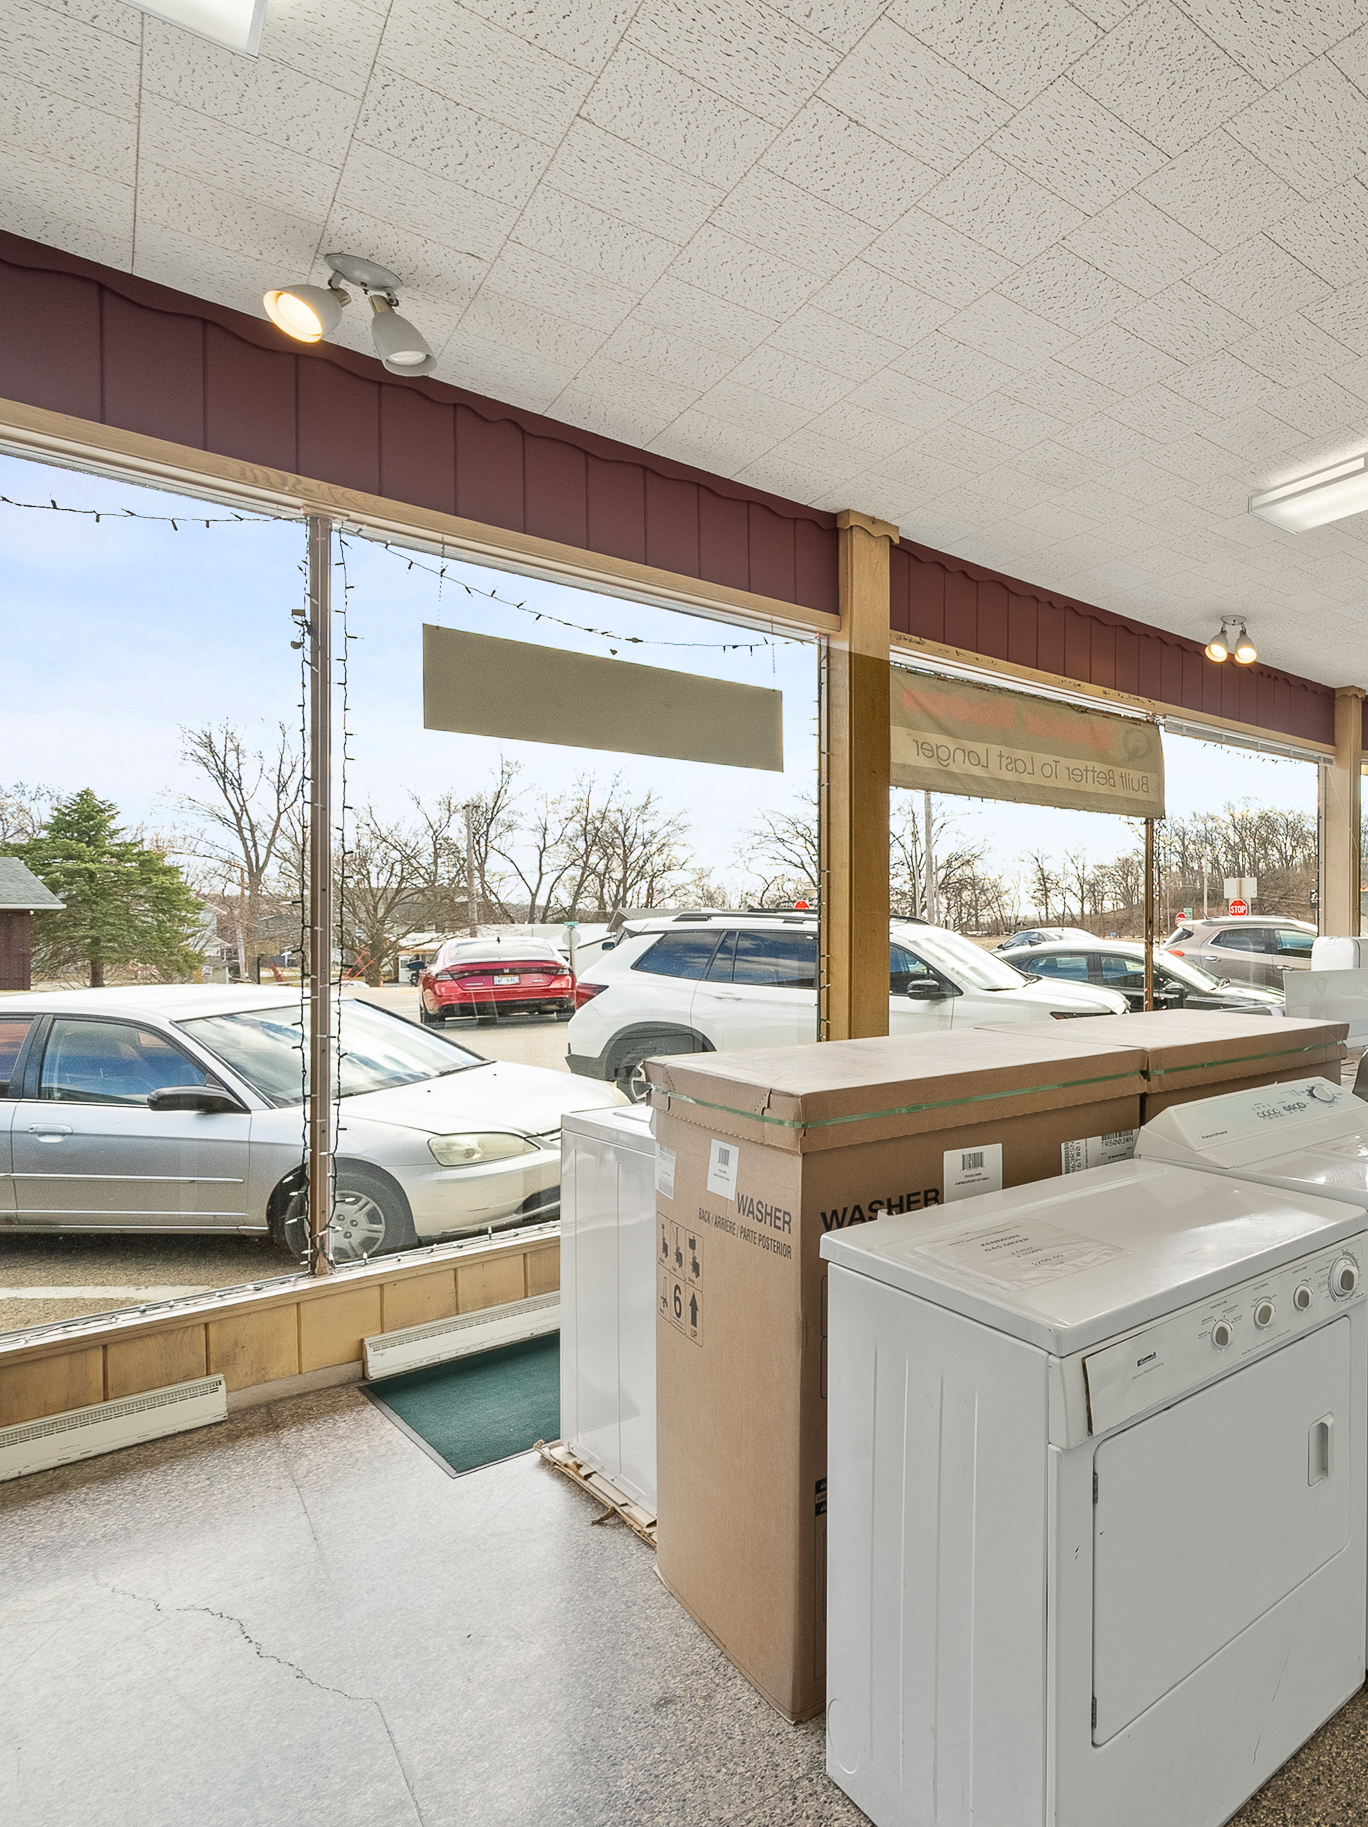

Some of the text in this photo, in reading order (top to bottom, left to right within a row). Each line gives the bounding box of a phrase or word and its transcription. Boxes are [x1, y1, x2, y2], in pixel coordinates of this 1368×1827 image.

[1230, 905, 1246, 914] STOP
[737, 1192, 792, 1235] WASHER
[820, 1188, 942, 1232] WASHER
[698, 1207, 711, 1225] BACK
[713, 1214, 736, 1236] ARRIÈRE
[740, 1225, 757, 1246] PARTE
[757, 1233, 792, 1260] POSTERIOR
[984, 1237, 1030, 1253] GAS DRYER
[673, 1284, 682, 1319] 6
[690, 1327, 697, 1338] UP
